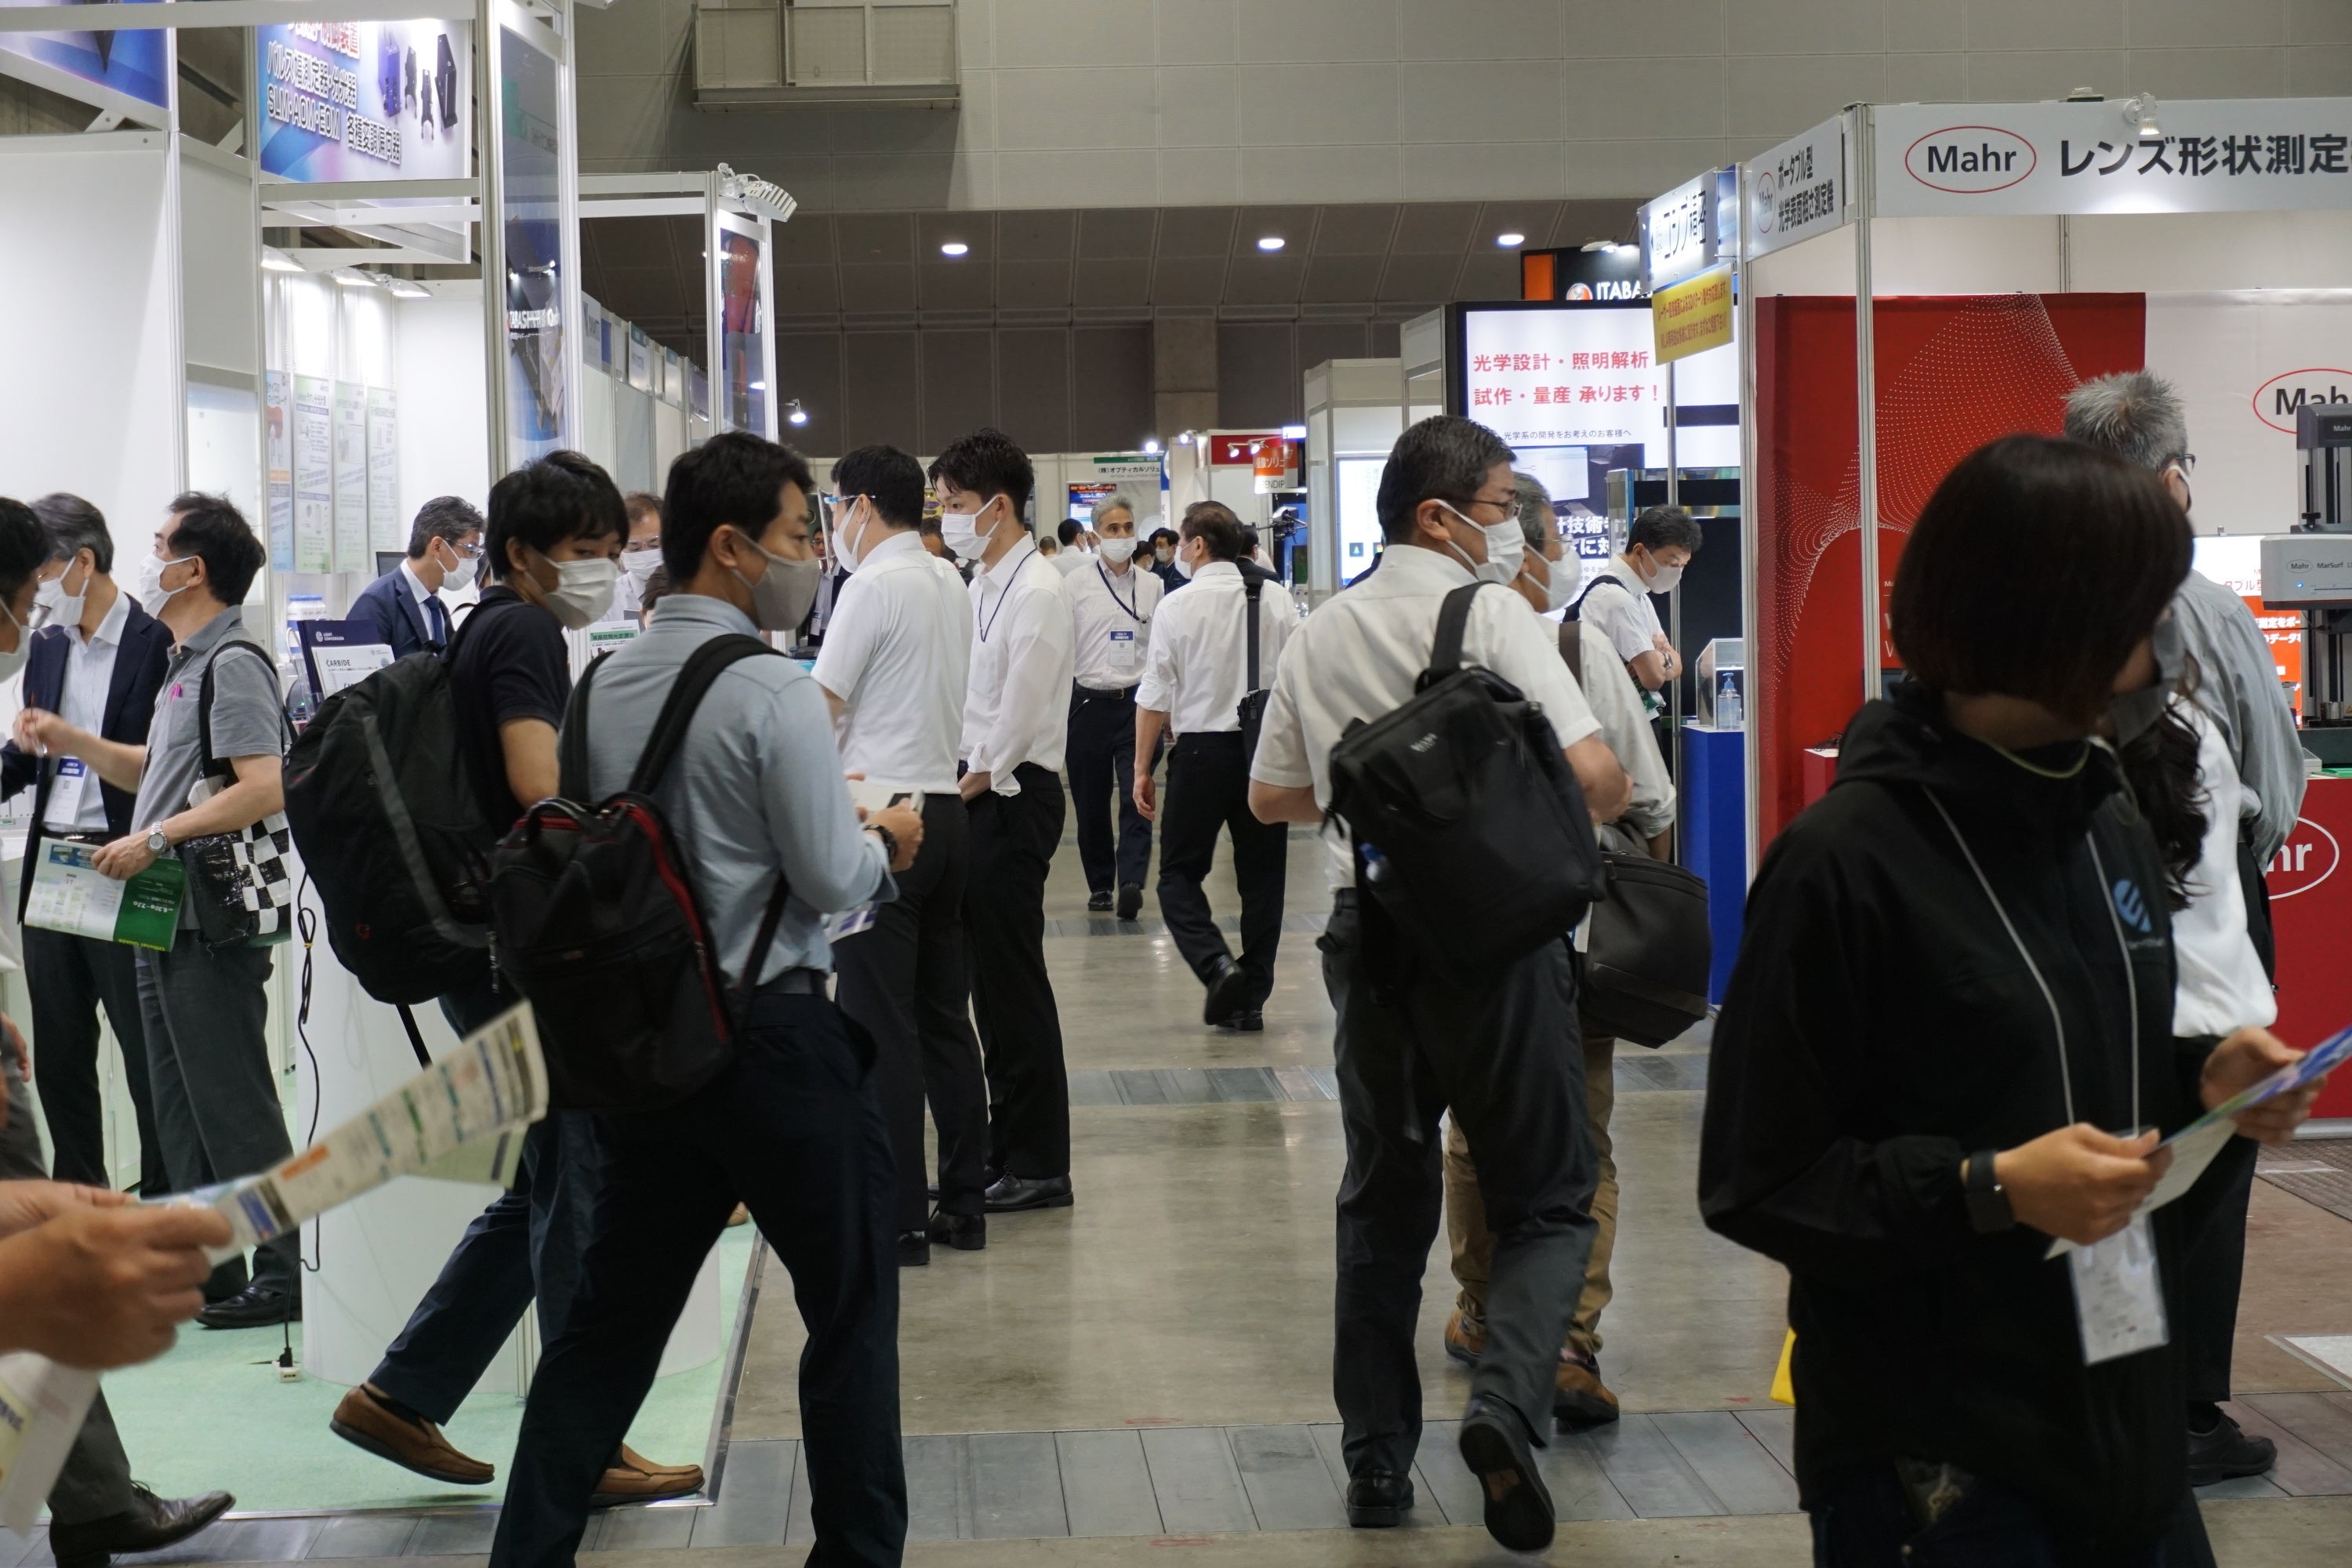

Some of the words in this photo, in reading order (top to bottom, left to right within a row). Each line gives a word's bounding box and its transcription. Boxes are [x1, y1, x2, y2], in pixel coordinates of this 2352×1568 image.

[1928, 143, 2016, 173] Mahr
[2060, 133, 2349, 177] レンズ形状測定
[1778, 144, 1813, 191] ポータブル型
[1759, 190, 1773, 217] Mahr
[1473, 350, 1649, 372] 光学設計・照明解析
[1474, 386, 1571, 406] 試作・量産
[1579, 384, 1658, 404] 承ります！
[1503, 430, 1632, 441] 光学系の開発をお考えのお客様へ
[2255, 616, 2300, 629] 測定をポー
